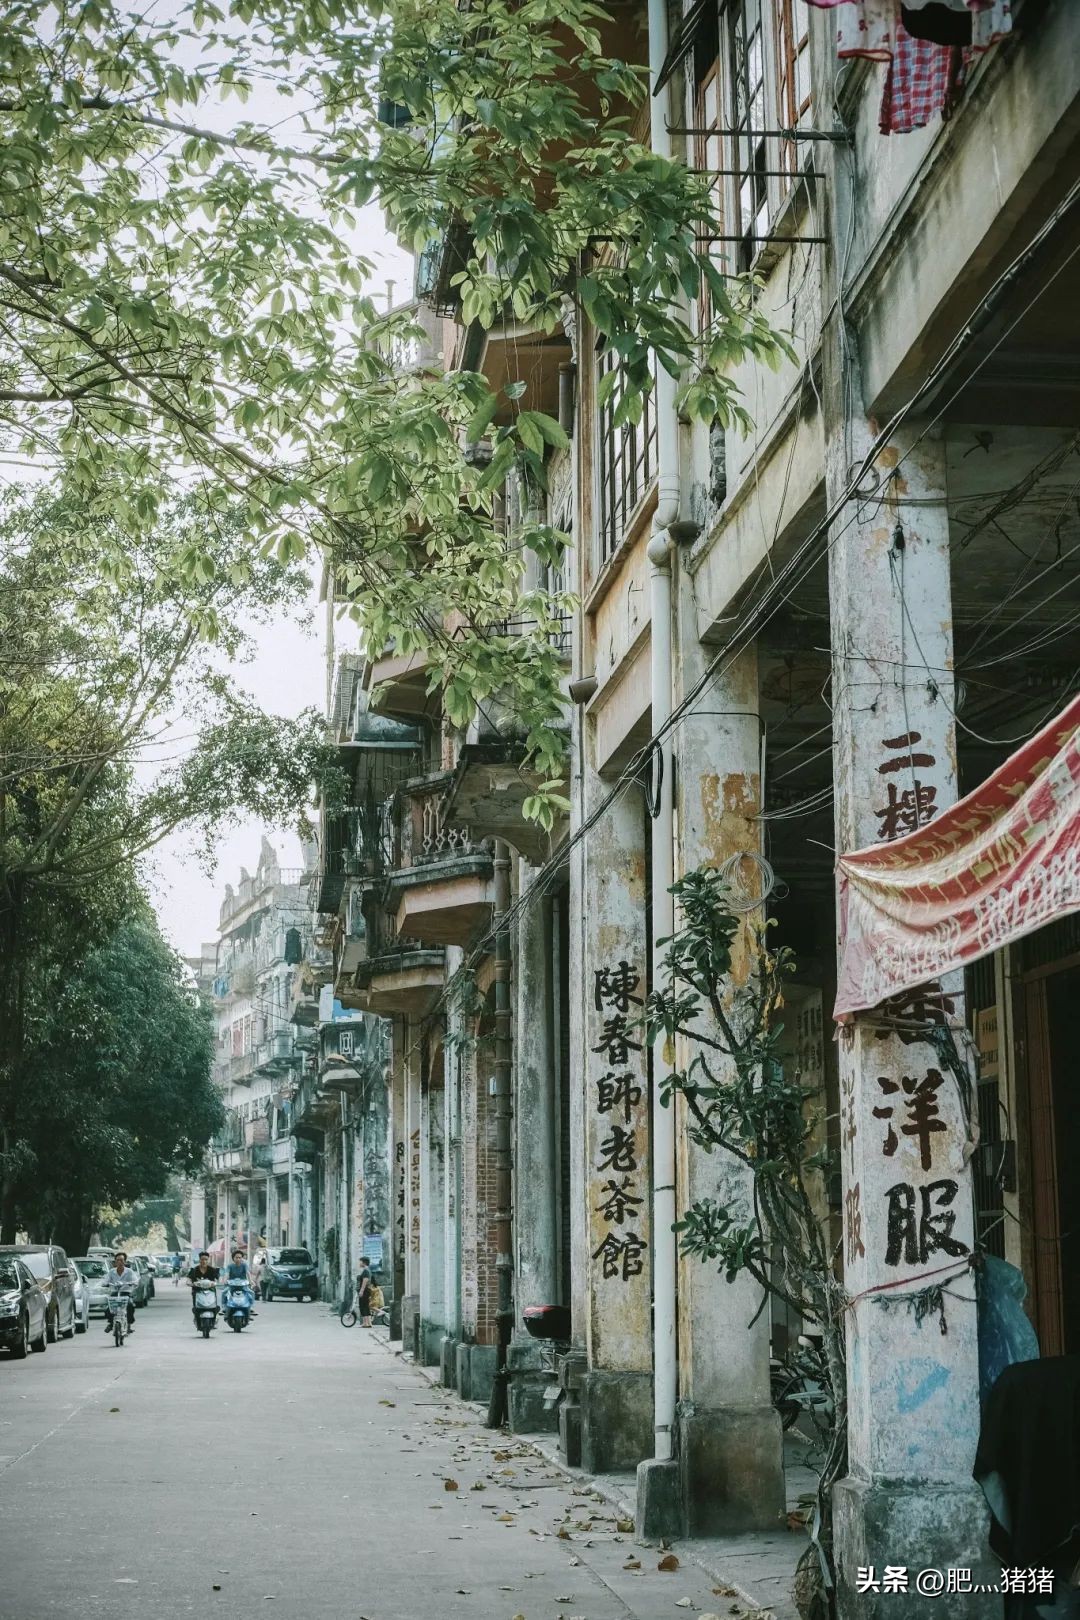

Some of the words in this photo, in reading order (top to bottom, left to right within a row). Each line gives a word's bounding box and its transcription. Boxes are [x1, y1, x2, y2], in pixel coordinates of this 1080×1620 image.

[591, 960, 648, 1282] 陳春師老茶館
